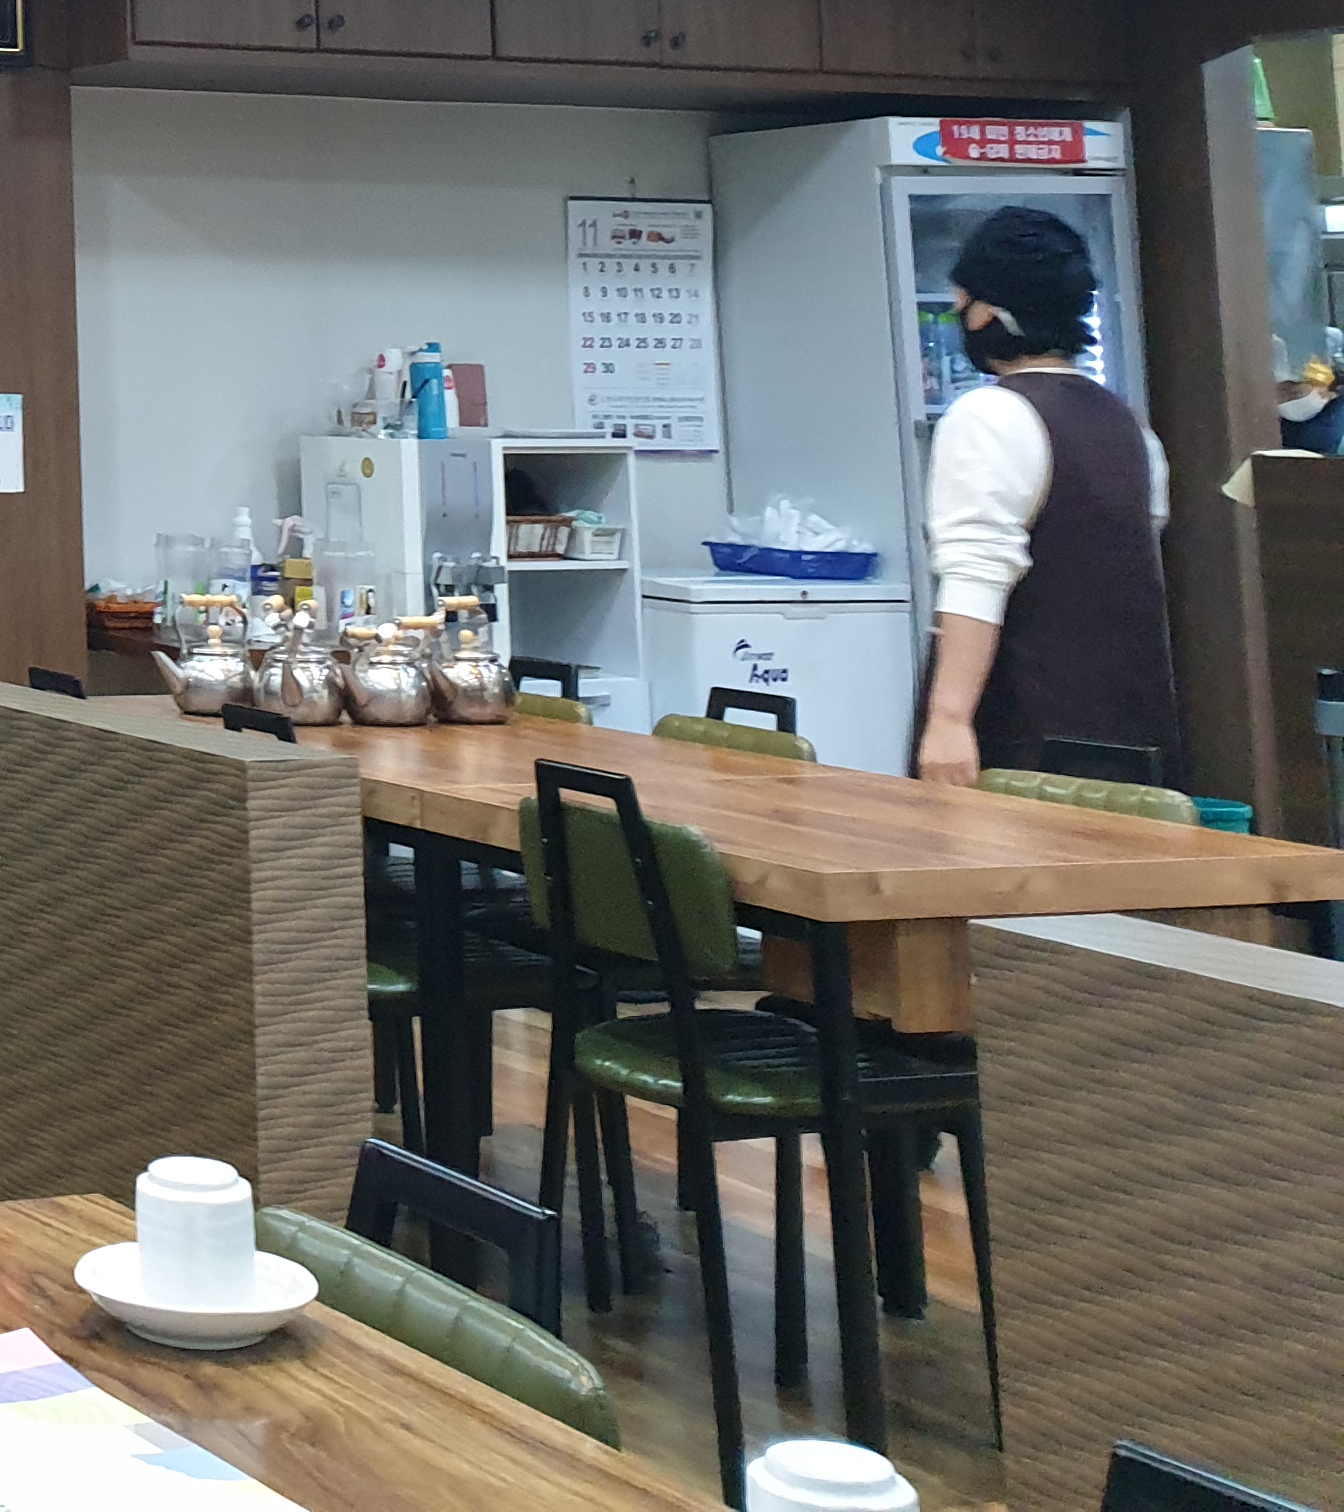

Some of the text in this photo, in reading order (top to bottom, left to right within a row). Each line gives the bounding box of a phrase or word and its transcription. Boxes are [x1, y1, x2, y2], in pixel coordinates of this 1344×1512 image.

[577, 218, 599, 248] 11
[582, 262, 587, 273] 1
[598, 262, 607, 273] 2
[615, 262, 623, 273] 3
[633, 262, 640, 273] 4
[650, 263, 658, 274] 5
[668, 263, 676, 274] 6
[583, 286, 590, 299] 8
[600, 286, 608, 299] 9
[615, 286, 628, 299] 10
[633, 286, 644, 299] 11
[650, 287, 663, 300] 12
[667, 287, 680, 300] 13
[581, 311, 595, 324] 15
[599, 311, 612, 324] 16
[616, 311, 629, 324] 17
[634, 311, 647, 324] 18
[652, 312, 665, 325] 19
[669, 312, 682, 325] 20
[581, 337, 594, 349] 22
[599, 337, 613, 349] 23
[617, 337, 630, 349] 24
[635, 337, 649, 349] 25
[653, 338, 667, 350] 26
[671, 338, 683, 350] 27
[583, 362, 615, 374] 29 30
[748, 663, 789, 686] Aqua
